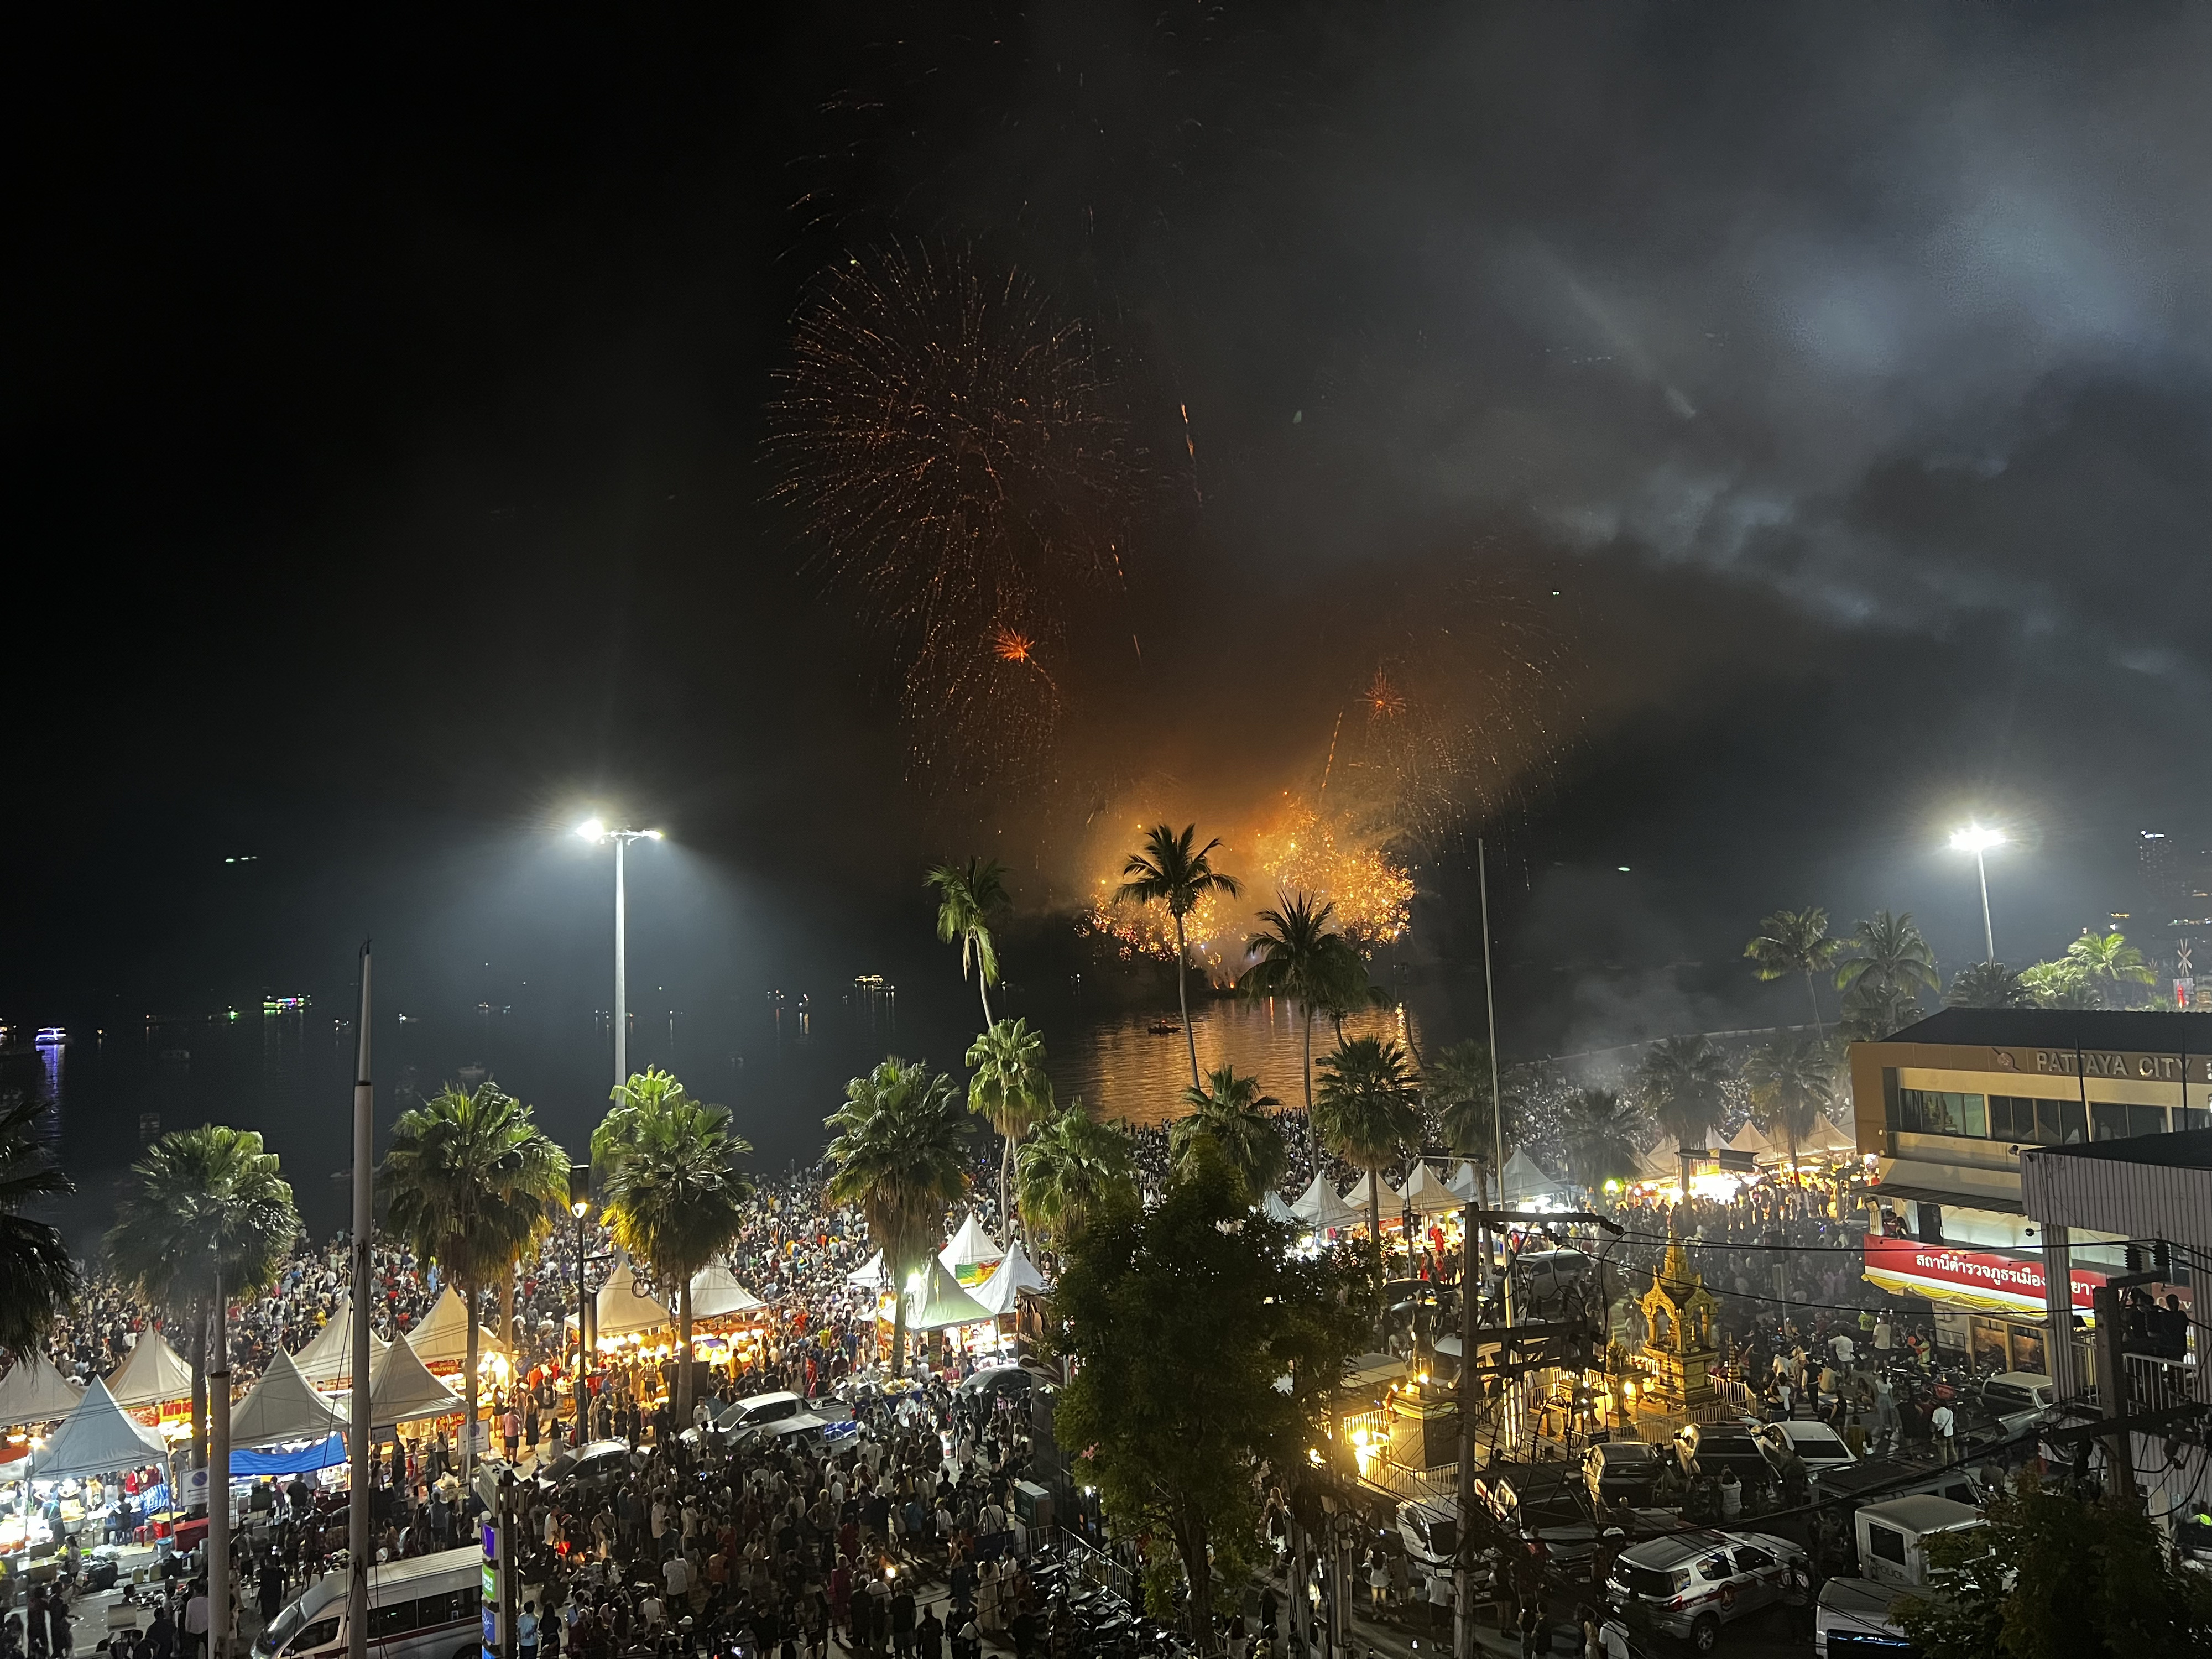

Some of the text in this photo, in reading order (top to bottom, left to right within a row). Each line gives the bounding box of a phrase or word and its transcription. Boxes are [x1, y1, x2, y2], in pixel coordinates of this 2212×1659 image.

[2037, 1052, 2128, 1076] PATTAYA
[2138, 1056, 2191, 1078] CITY
[1875, 1563, 1904, 1580] POLICE
